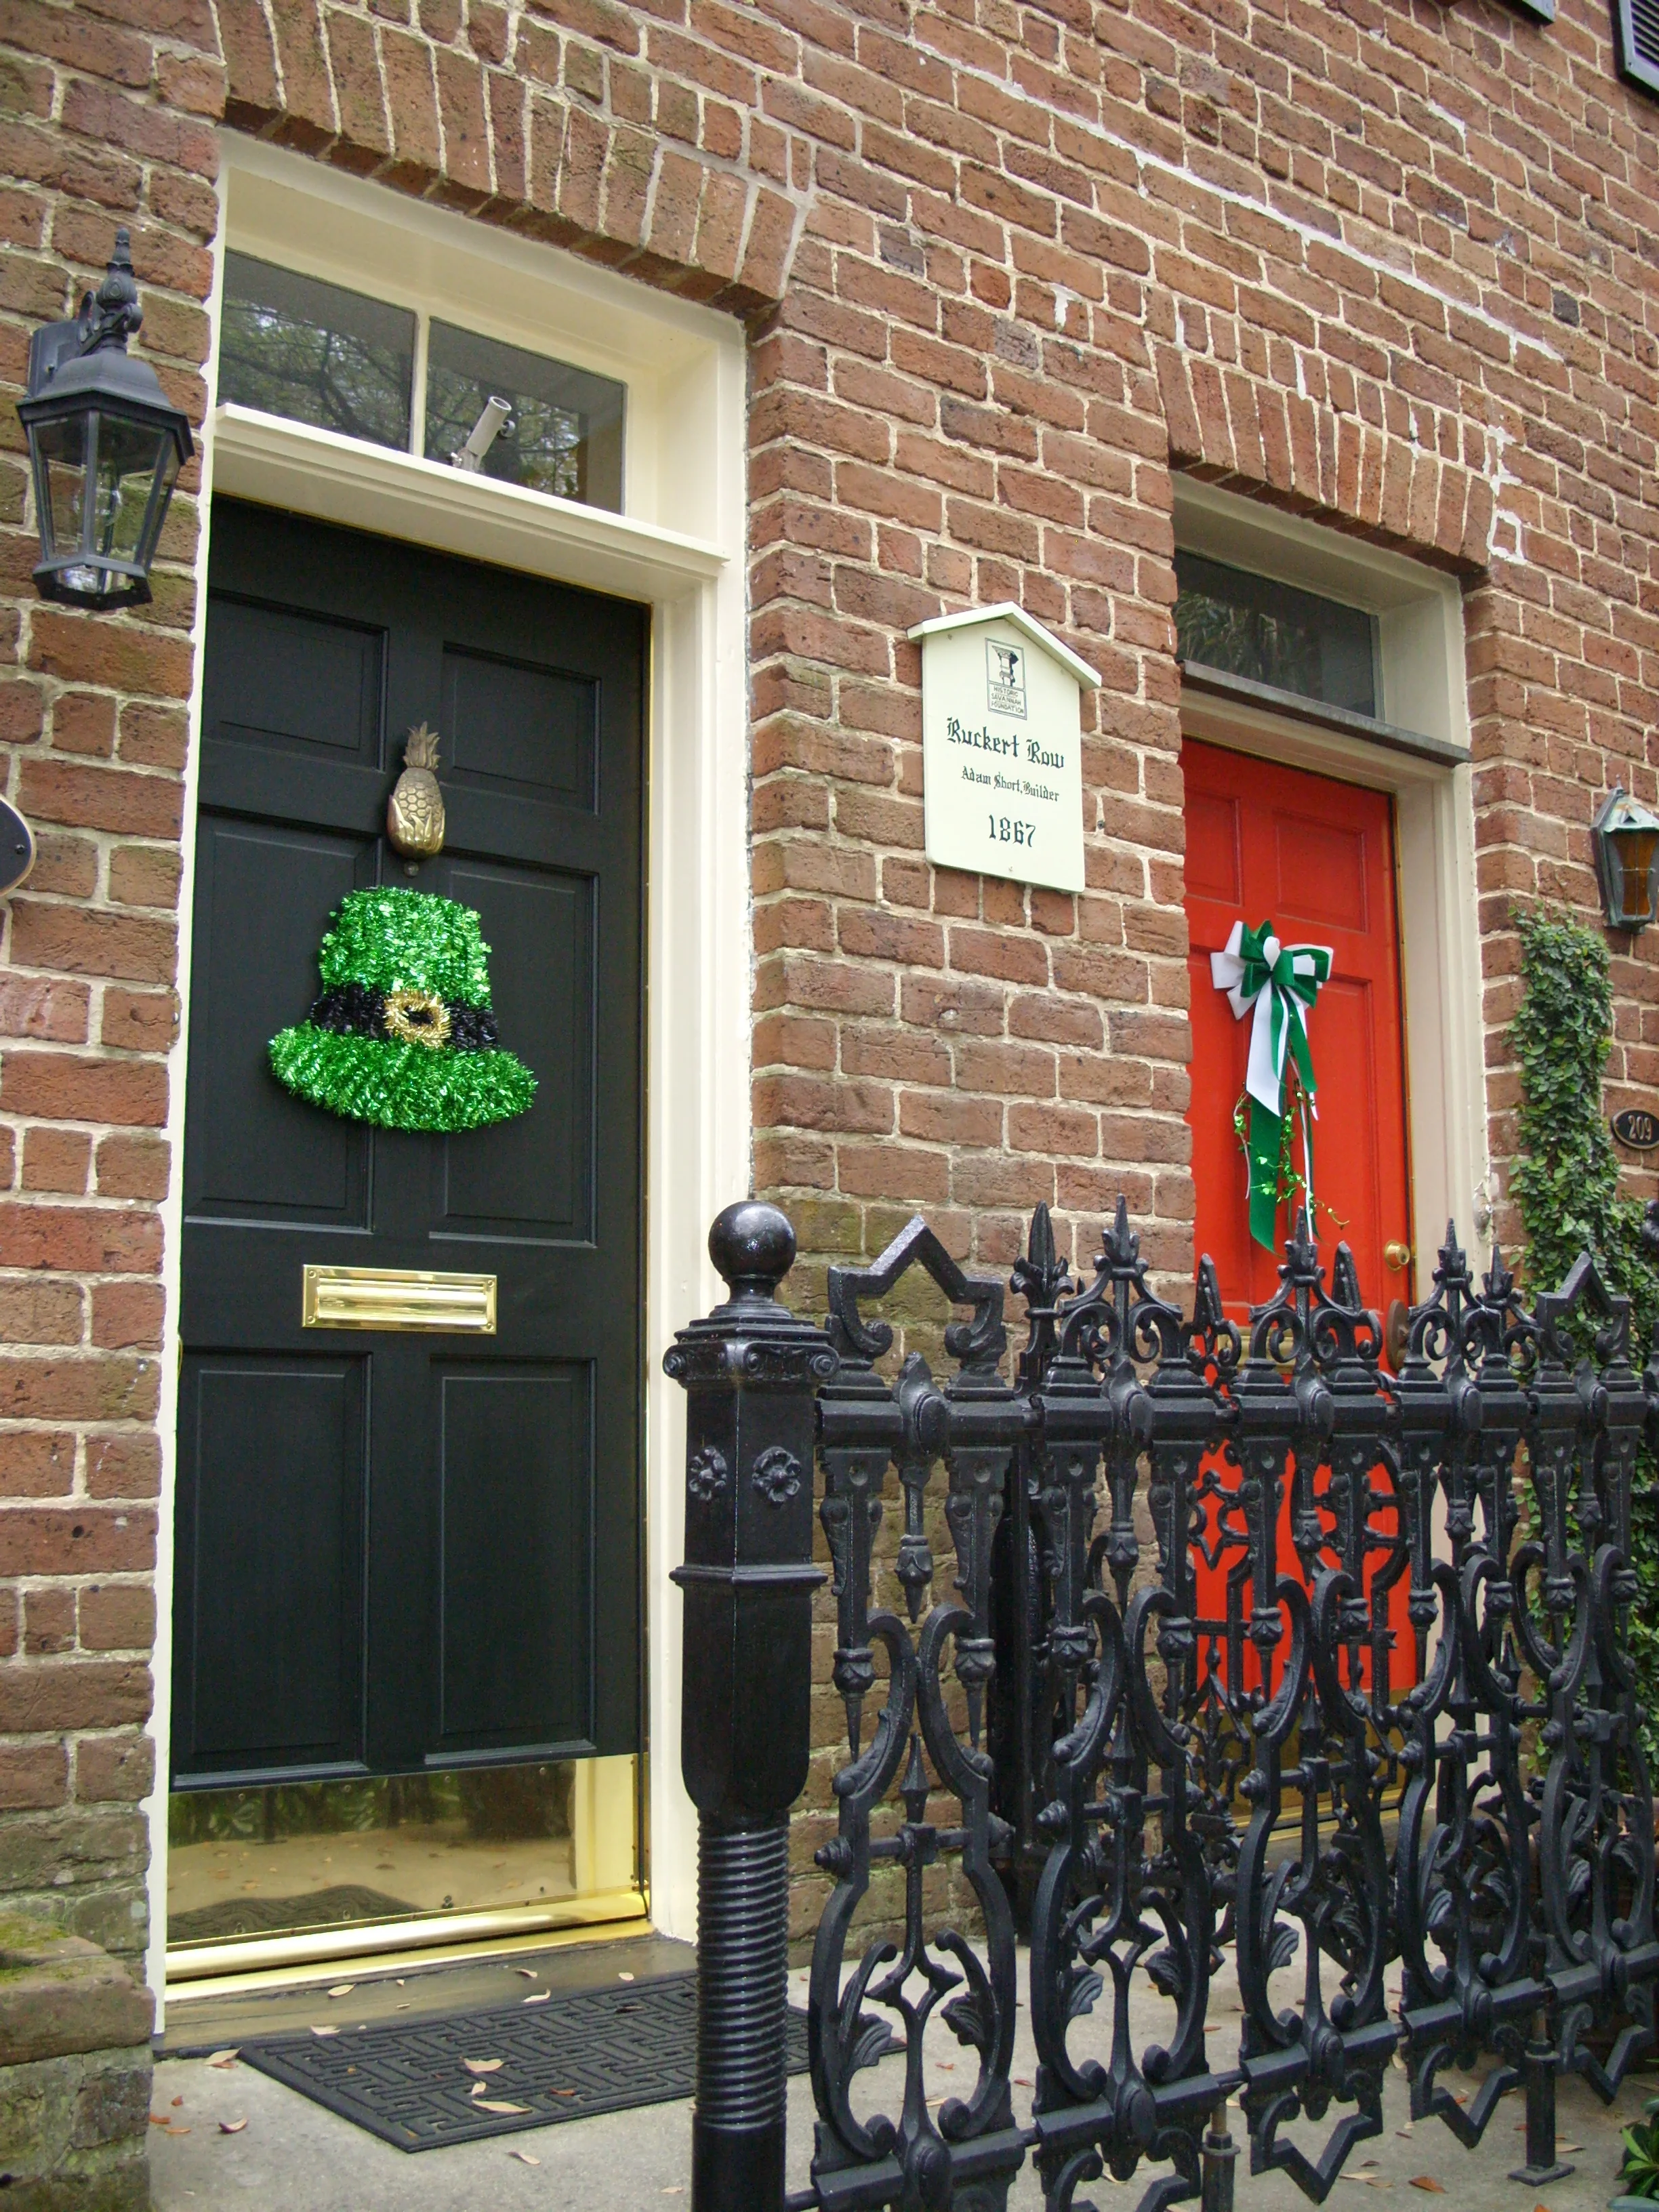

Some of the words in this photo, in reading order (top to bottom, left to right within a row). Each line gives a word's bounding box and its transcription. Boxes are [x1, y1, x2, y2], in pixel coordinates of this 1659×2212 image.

[991, 693, 1021, 706] SAVANNAH
[994, 684, 1019, 697] HISTORIC
[991, 700, 1024, 714] FOUNDATION
[947, 716, 1020, 758] Ruckert
[1026, 739, 1065, 769] Row
[961, 765, 991, 785] Adam
[1022, 781, 1059, 802] Builder
[988, 814, 1036, 848] 1867
[1628, 1115, 1653, 1141] 209
